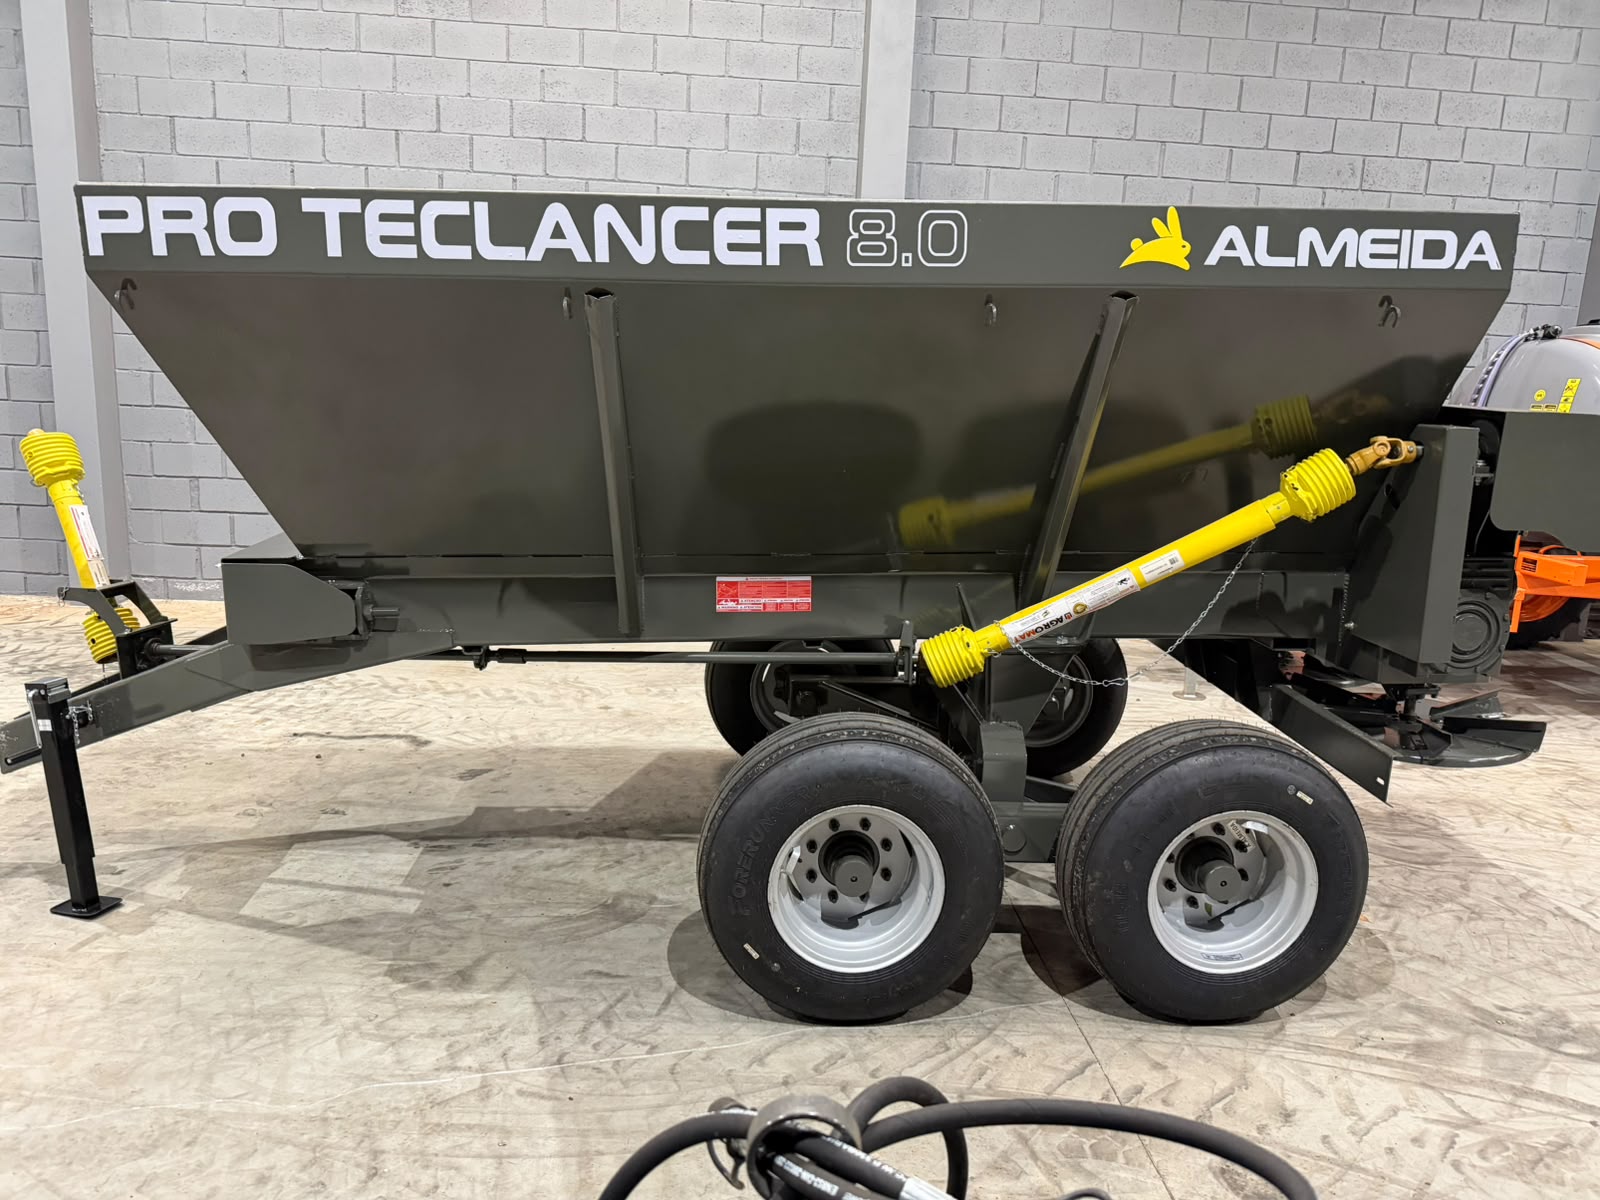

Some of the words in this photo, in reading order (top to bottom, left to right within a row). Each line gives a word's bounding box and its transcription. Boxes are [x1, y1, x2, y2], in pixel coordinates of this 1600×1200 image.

[83, 195, 278, 258] PRO
[300, 197, 824, 267] TECLANCER
[846, 208, 969, 268] 8.0
[1203, 224, 1502, 271] ALMEIDA
[1012, 614, 1065, 645] AGROMAT
